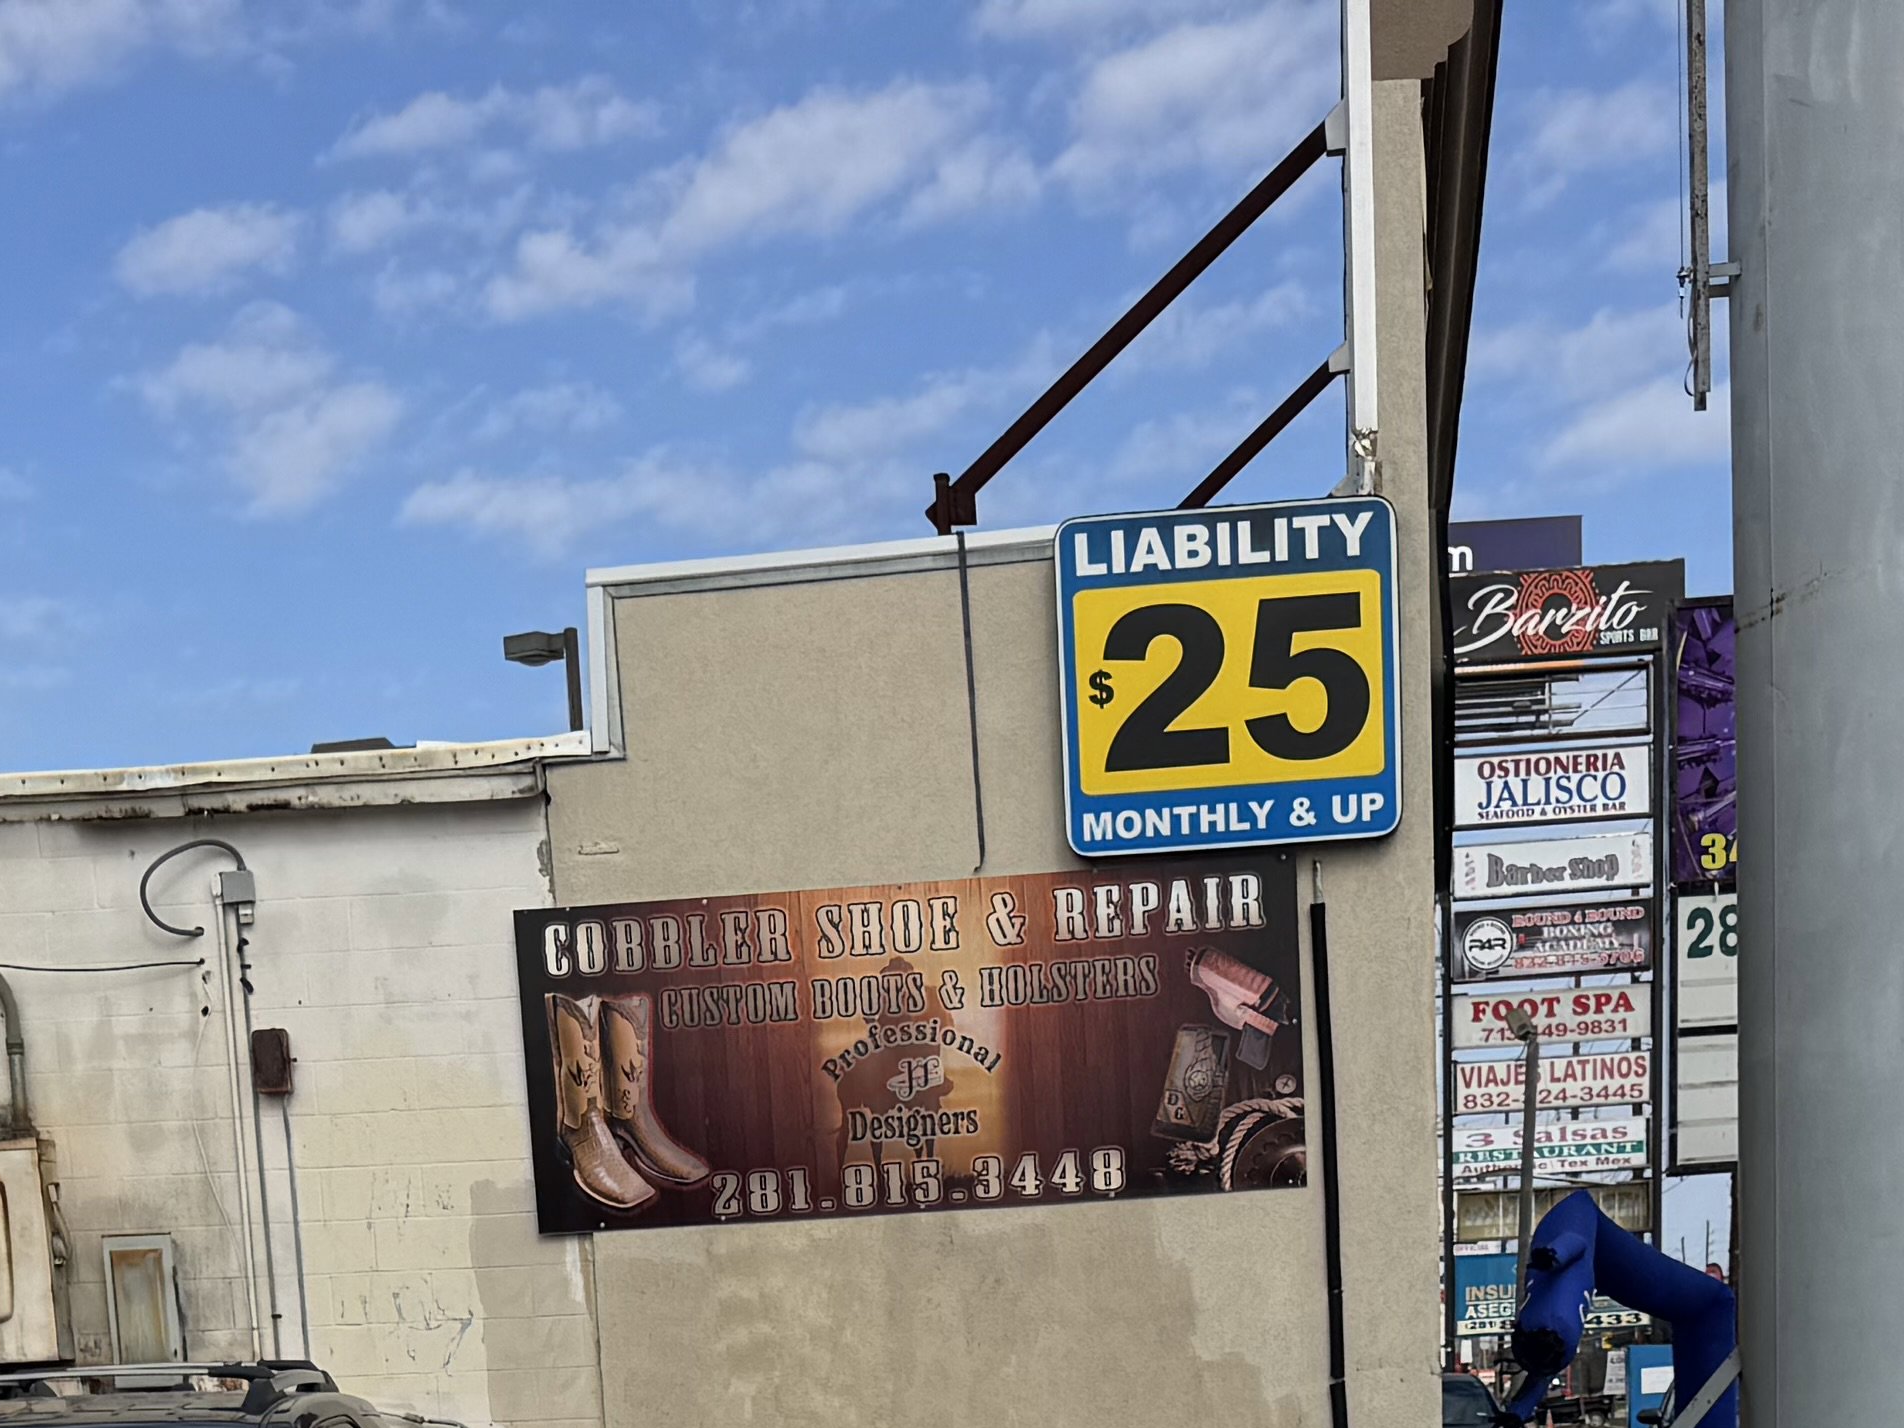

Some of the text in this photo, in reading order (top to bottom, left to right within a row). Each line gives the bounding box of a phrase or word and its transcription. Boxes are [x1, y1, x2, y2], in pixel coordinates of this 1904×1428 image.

[1074, 511, 1374, 577] LIABILITY
[1453, 580, 1654, 654] Barzito
[1477, 751, 1626, 780] OSTIONERIA
[1477, 772, 1627, 810] JALISCO
[1082, 793, 1385, 842] MONTHLY & UP
[1477, 807, 1535, 821] SEAFOOD
[1553, 803, 1597, 816] OYSTER
[1602, 801, 1627, 812] BAR
[1486, 852, 1621, 889] Barber Shop
[543, 873, 1265, 978] COBBLER SHOE & REPAIR
[1542, 922, 1616, 938] BOXING
[1534, 936, 1620, 953] ACADEMY
[660, 954, 1161, 1031] CUSTOM BOOTS & HOLSTERS
[1471, 991, 1636, 1023] FOOT SPA
[821, 1019, 1003, 1081] Professional
[1550, 1056, 1647, 1083] LATINOS
[1463, 1083, 1644, 1110] 832-24-3445
[849, 1105, 979, 1148] Designers
[1465, 1132, 1494, 1148] 3
[1559, 1158, 1589, 1169] Tex
[1596, 1156, 1632, 1167] Mex
[709, 1146, 1127, 1219] 281.815.3448
[1465, 1284, 1517, 1302] INSU
[1465, 1302, 1516, 1319] ASEG
